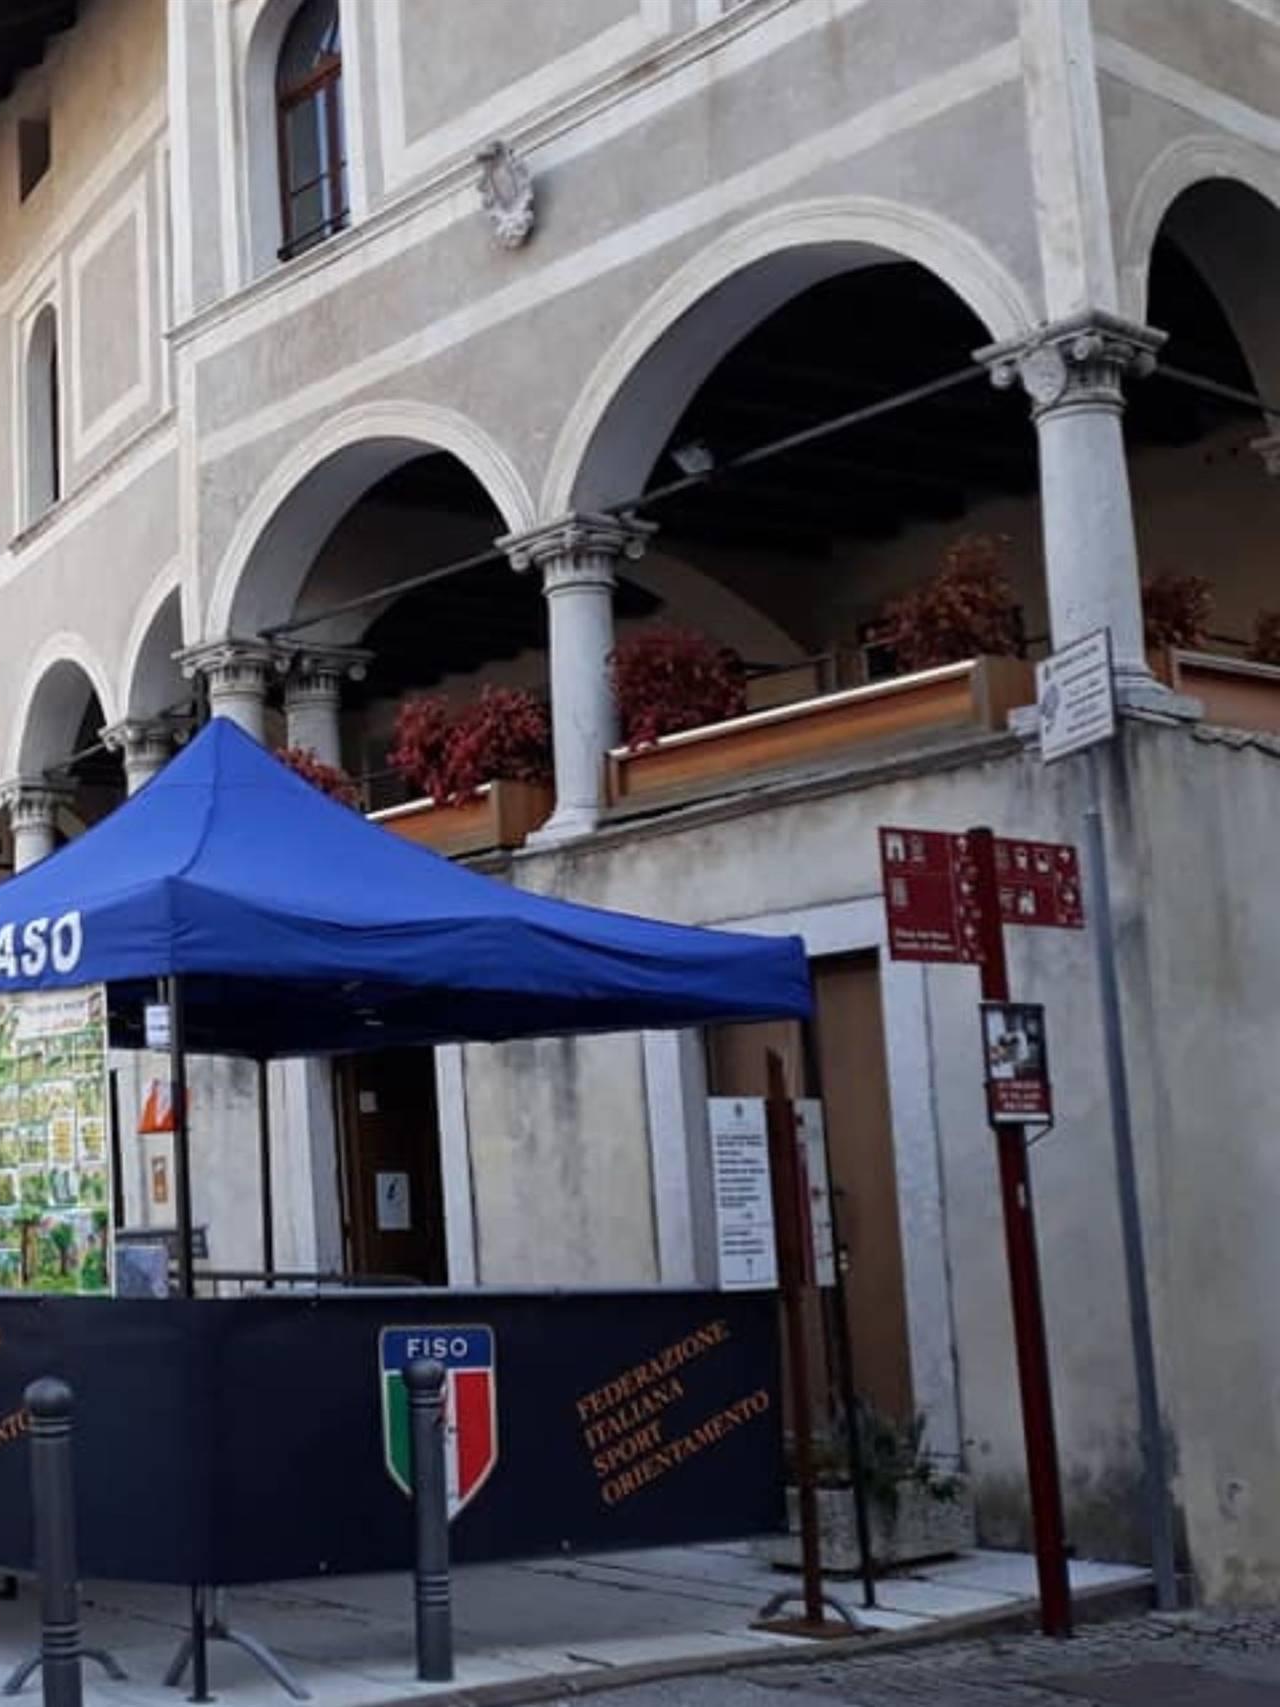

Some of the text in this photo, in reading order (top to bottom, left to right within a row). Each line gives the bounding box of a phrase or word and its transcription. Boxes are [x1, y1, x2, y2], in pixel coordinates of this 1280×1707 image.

[406, 1336, 469, 1359] FISO
[575, 1320, 730, 1421] FEDERAZIONE
[584, 1376, 685, 1450] ITALIANA
[593, 1421, 662, 1477] SPORT
[601, 1389, 770, 1505] ORIENTAMENTO
